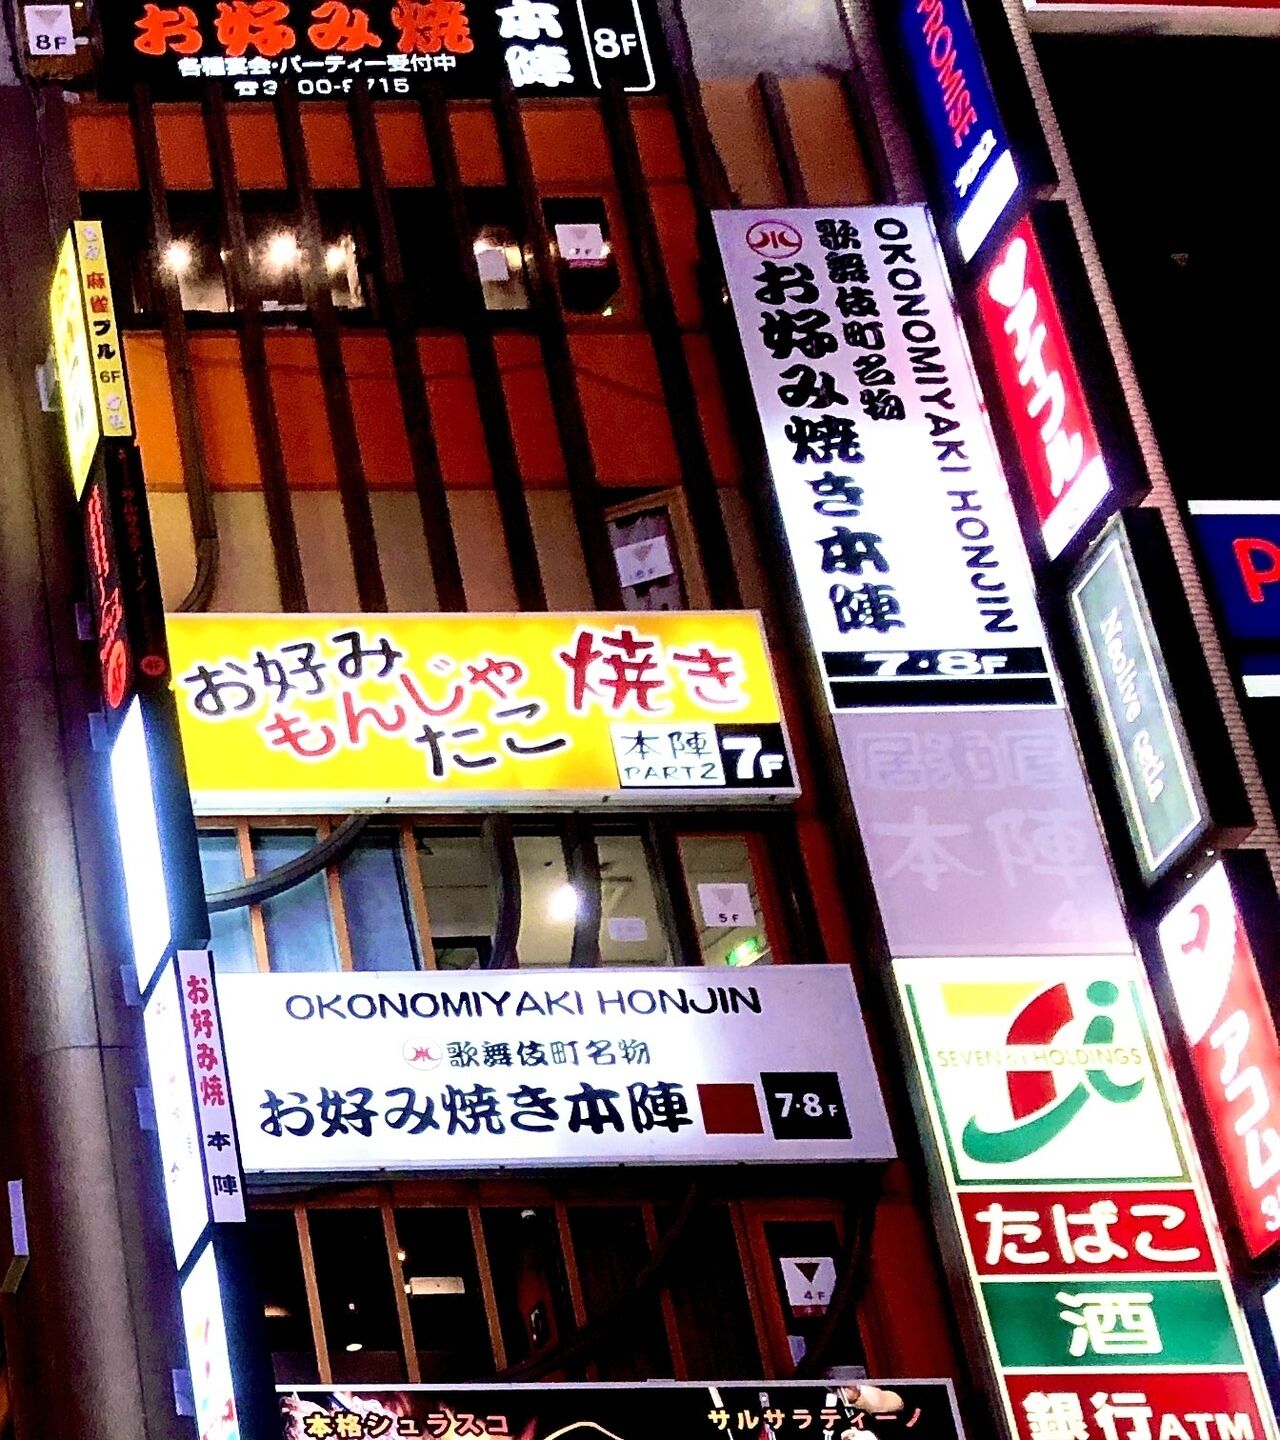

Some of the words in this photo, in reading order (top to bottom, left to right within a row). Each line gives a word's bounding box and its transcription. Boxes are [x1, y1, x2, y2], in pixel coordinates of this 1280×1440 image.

[36, 34, 67, 51] 8F
[594, 29, 637, 59] 8F
[815, 217, 907, 422] 歌舞伎町名物
[100, 370, 121, 383] 6F
[873, 217, 973, 475] OKONOMIYAKI
[947, 487, 1019, 634] HONJIN
[753, 260, 907, 635] お好み焼き本陣
[184, 630, 403, 717] お好み
[558, 628, 740, 712] 焼き
[265, 655, 524, 758] もんじゃ
[623, 729, 712, 760] 本陣
[723, 737, 783, 780] 7F
[718, 913, 739, 923] 5F
[285, 988, 584, 1021] OKONOMIYAKI
[598, 986, 763, 1016] HONJIN
[447, 1039, 652, 1069] 歌舞伎町名物
[1034, 1049, 1142, 1067] HOLDINGS
[186, 974, 226, 1107] お好み焼
[206, 1130, 239, 1198] 本陣
[258, 1081, 695, 1139] お好み焼き本陣
[974, 1200, 1201, 1266] たばこ
[803, 1291, 826, 1301] 4F
[1055, 1290, 1164, 1357] 酒
[305, 1412, 512, 1438] 本格シュラスコ
[707, 1407, 923, 1432] サルサラティーノ
